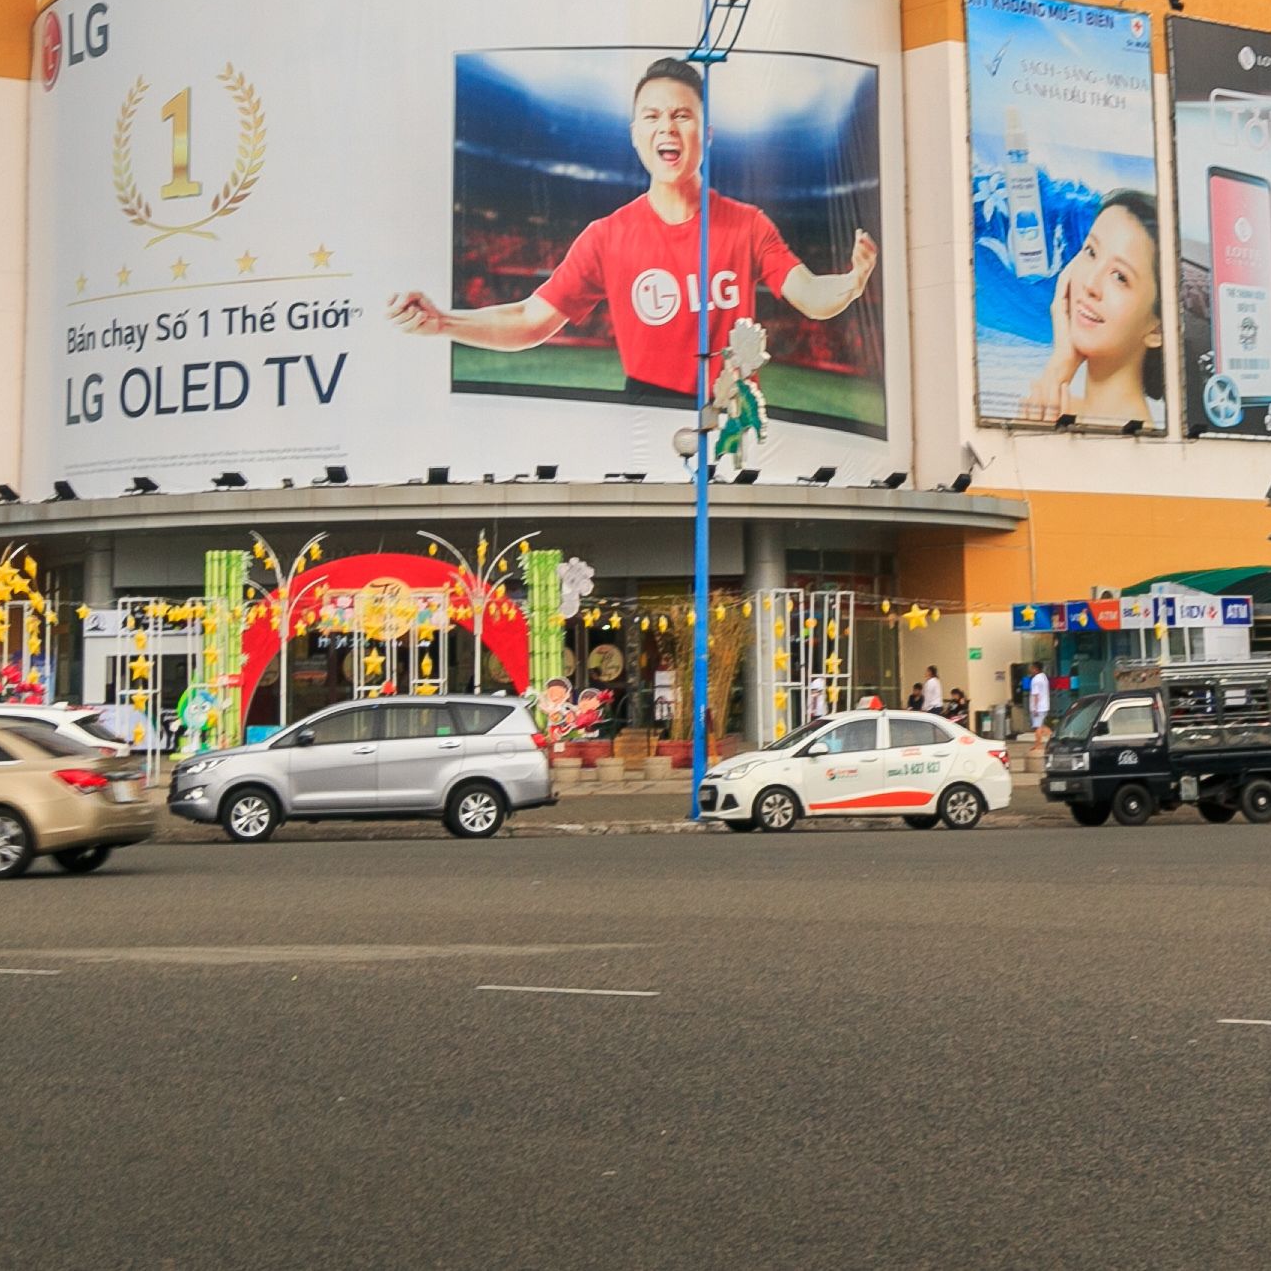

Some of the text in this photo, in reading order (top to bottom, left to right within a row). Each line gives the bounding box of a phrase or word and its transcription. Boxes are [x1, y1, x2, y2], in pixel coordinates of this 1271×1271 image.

[67, 3, 110, 66] LG
[161, 86, 203, 199] 1
[687, 270, 740, 312] LG
[67, 324, 96, 355] Bán
[101, 317, 148, 353] chạy
[156, 308, 189, 342] Số
[198, 309, 211, 338] 1
[222, 300, 276, 336] Thế
[66, 352, 349, 427] LG OLED TV
